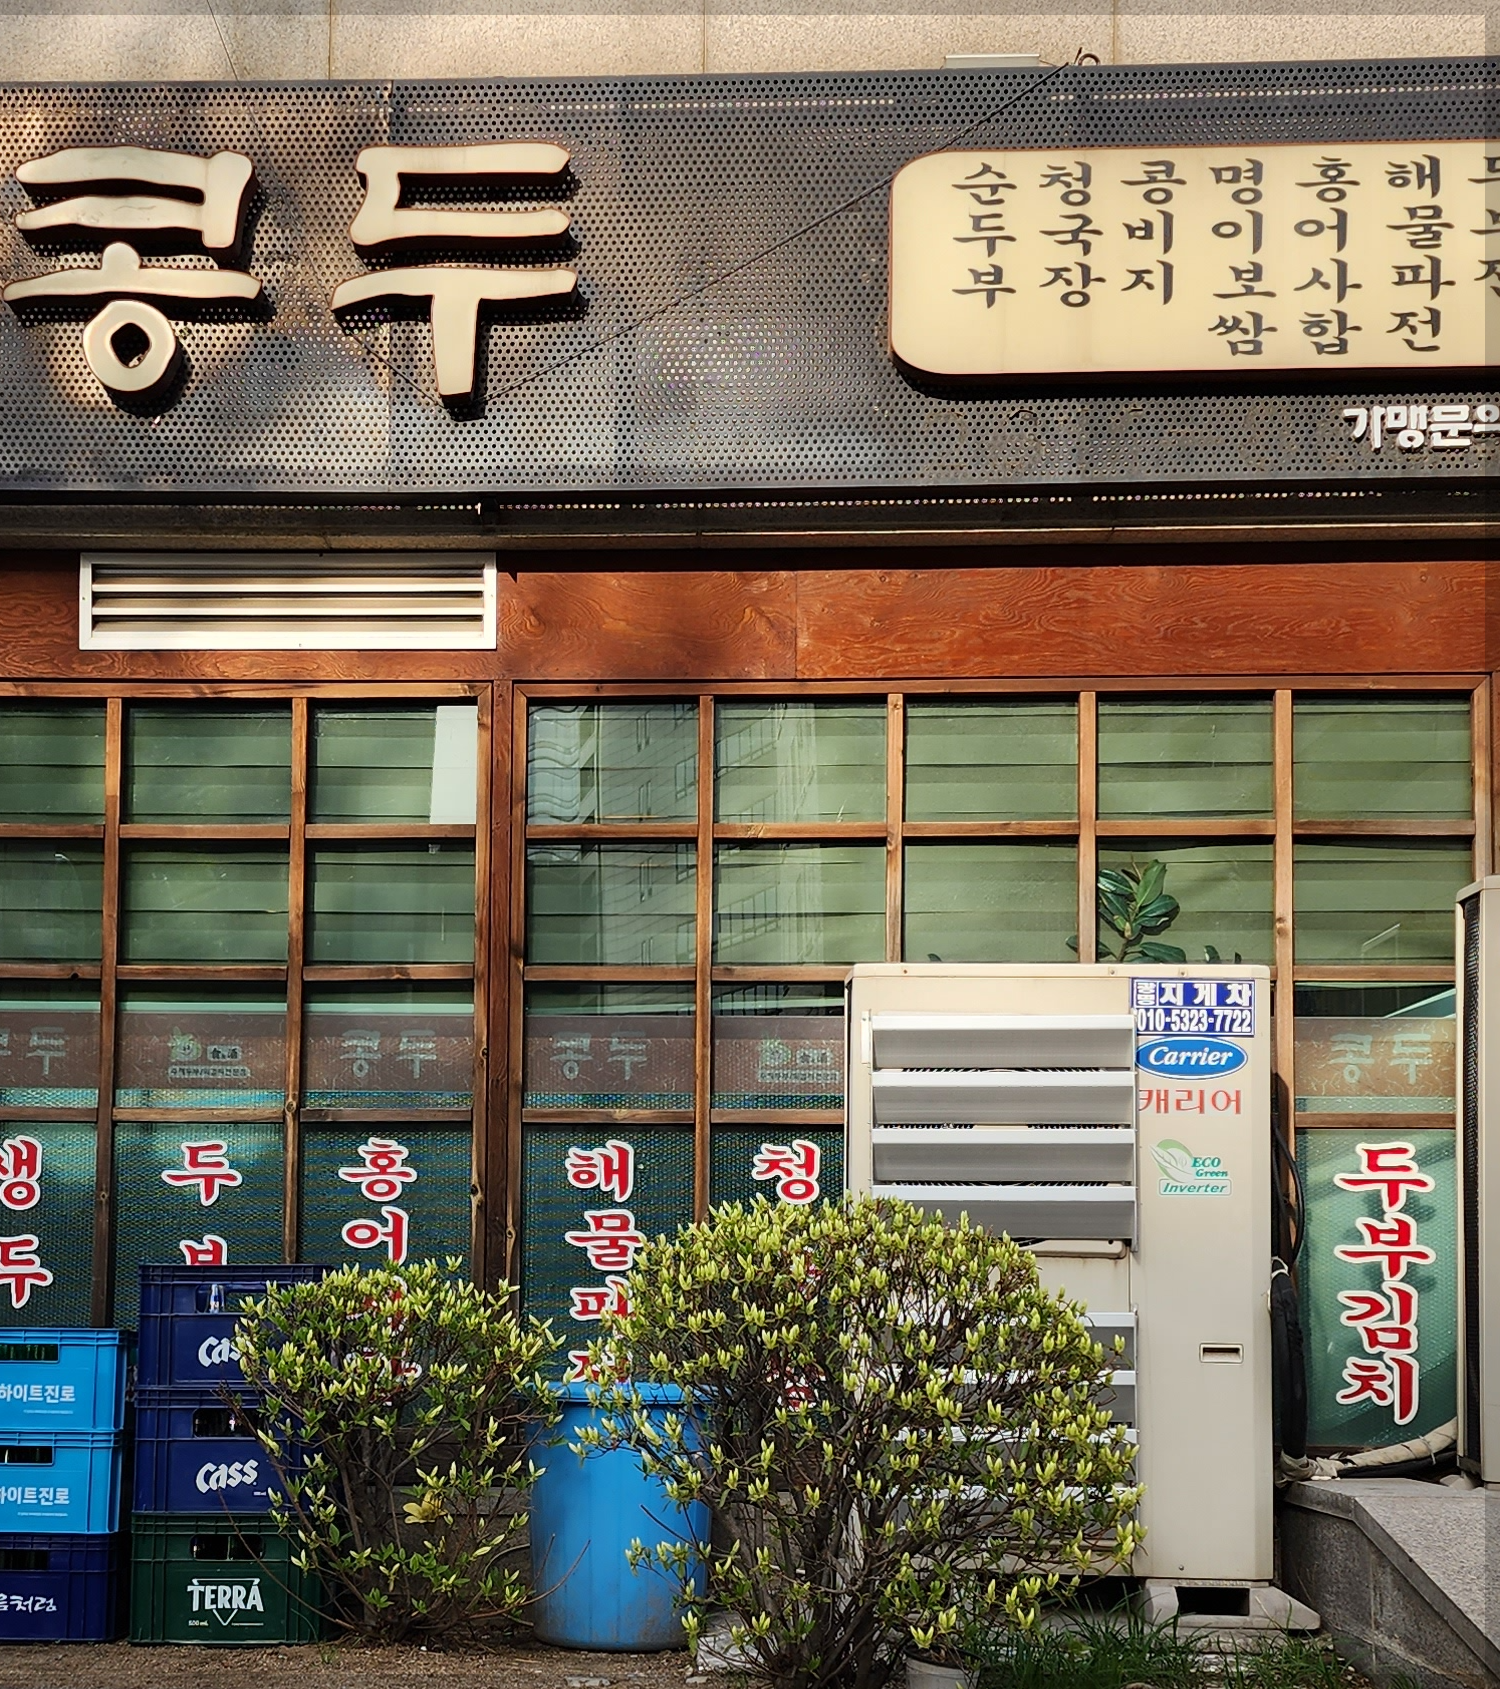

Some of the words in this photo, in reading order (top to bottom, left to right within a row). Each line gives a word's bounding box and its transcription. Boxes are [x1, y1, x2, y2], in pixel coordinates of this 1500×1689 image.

[951, 161, 1017, 309] 순두부
[1039, 160, 1107, 308] 청국장
[1120, 159, 1188, 306] 콩비지
[1207, 157, 1278, 357] 명이보쌈
[1385, 153, 1456, 352] 해물파전
[3, 143, 577, 396] 콩두
[1136, 1008, 1252, 1033] 010-5323-7722
[1147, 1046, 1234, 1066] Carrier
[1329, 1033, 1433, 1085] 콩두
[1138, 1088, 1242, 1115] 캐리어
[1162, 1182, 1229, 1194] Inverter
[1190, 1156, 1222, 1168] ECO
[1195, 1168, 1228, 1178] Green
[1333, 1141, 1436, 1426] 두부김치
[186, 1585, 265, 1612] TERRA
